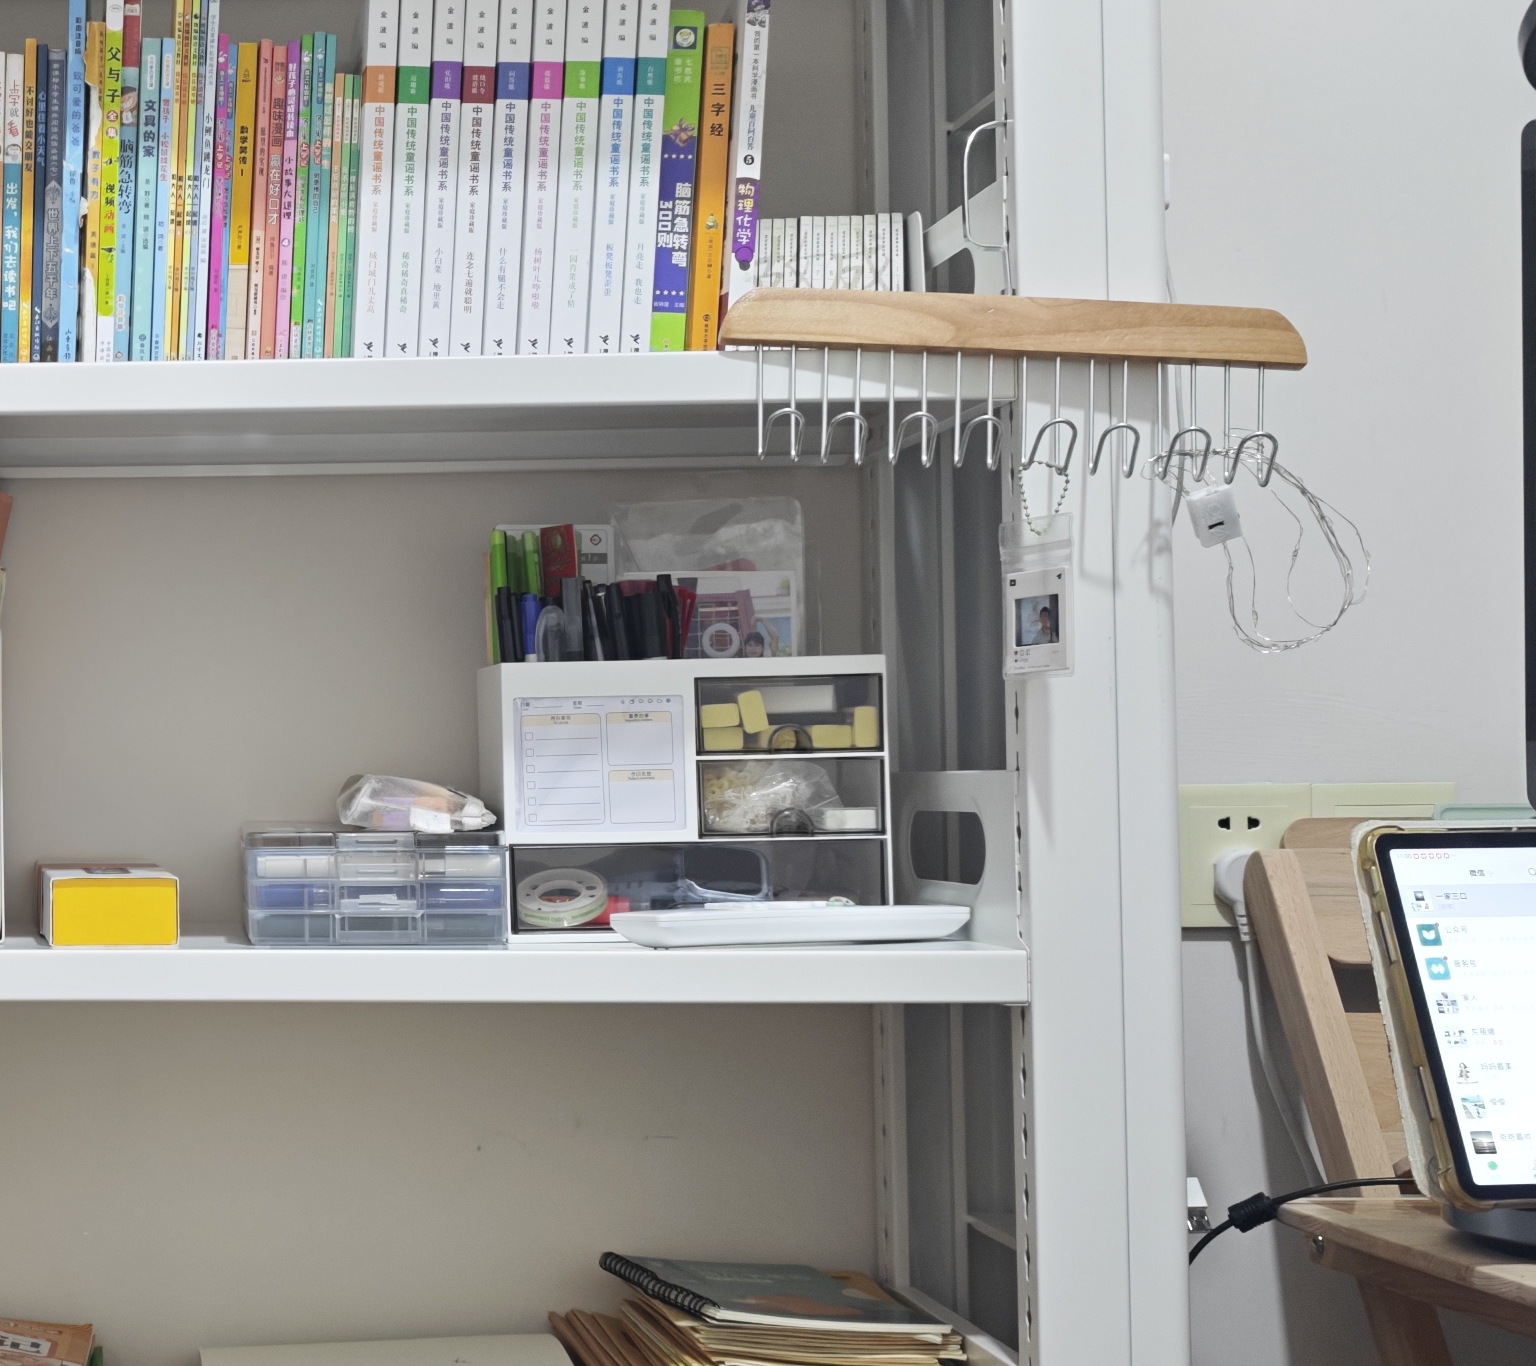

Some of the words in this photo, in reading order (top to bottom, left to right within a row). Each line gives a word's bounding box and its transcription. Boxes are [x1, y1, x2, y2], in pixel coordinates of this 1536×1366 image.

[379, 11, 388, 49] 金波编
[106, 46, 121, 138] 父与子全集
[750, 30, 761, 100] 我的第一本科学漫画书
[7, 79, 20, 137] 上学就看
[24, 86, 35, 172] 不讨好也能交朋友
[71, 71, 82, 147] 致可爱的爸爸
[142, 100, 156, 159] 文具的家
[271, 97, 284, 147] 趣味漫画
[710, 83, 726, 137] 三字经
[747, 104, 757, 151] 儿童百问百答
[90, 150, 101, 199] 教子有方
[117, 139, 134, 214] 脑筋急转弯
[203, 113, 212, 189] 小鲤鱼跳龙门
[371, 105, 385, 196] 中国传统童谣书系
[403, 106, 417, 197] 中国传统童谣书系
[437, 101, 452, 192] 中国传统童谣书系
[469, 105, 483, 196] 中国传统童谣书系
[501, 102, 516, 192] 中国传统童谣书系
[536, 101, 551, 192] 中国传统童谣书系
[283, 156, 294, 220] 小故事大道理
[736, 183, 755, 245] 物理化学
[44, 208, 60, 300] 世界上下五千年
[635, 243, 644, 270] 月亮走
[671, 182, 692, 268] 脑筋急转弯
[367, 251, 377, 314] 城门城门几丈高
[399, 251, 410, 314] 稀奇稀奇真稀奇
[434, 247, 444, 274] 小白菜
[463, 251, 474, 314] 连念七遍就聪明
[497, 247, 507, 310] 什么有腿不会走
[531, 248, 543, 310] 杨树叶儿哗啦啦
[567, 247, 578, 309] 一园青菜成了精
[603, 243, 614, 297] 板凳板凳歪歪
[634, 278, 643, 305] 我也走
[1435, 892, 1468, 901] 一家三口
[1469, 869, 1486, 877] 微信
[1444, 926, 1468, 934] 公众号
